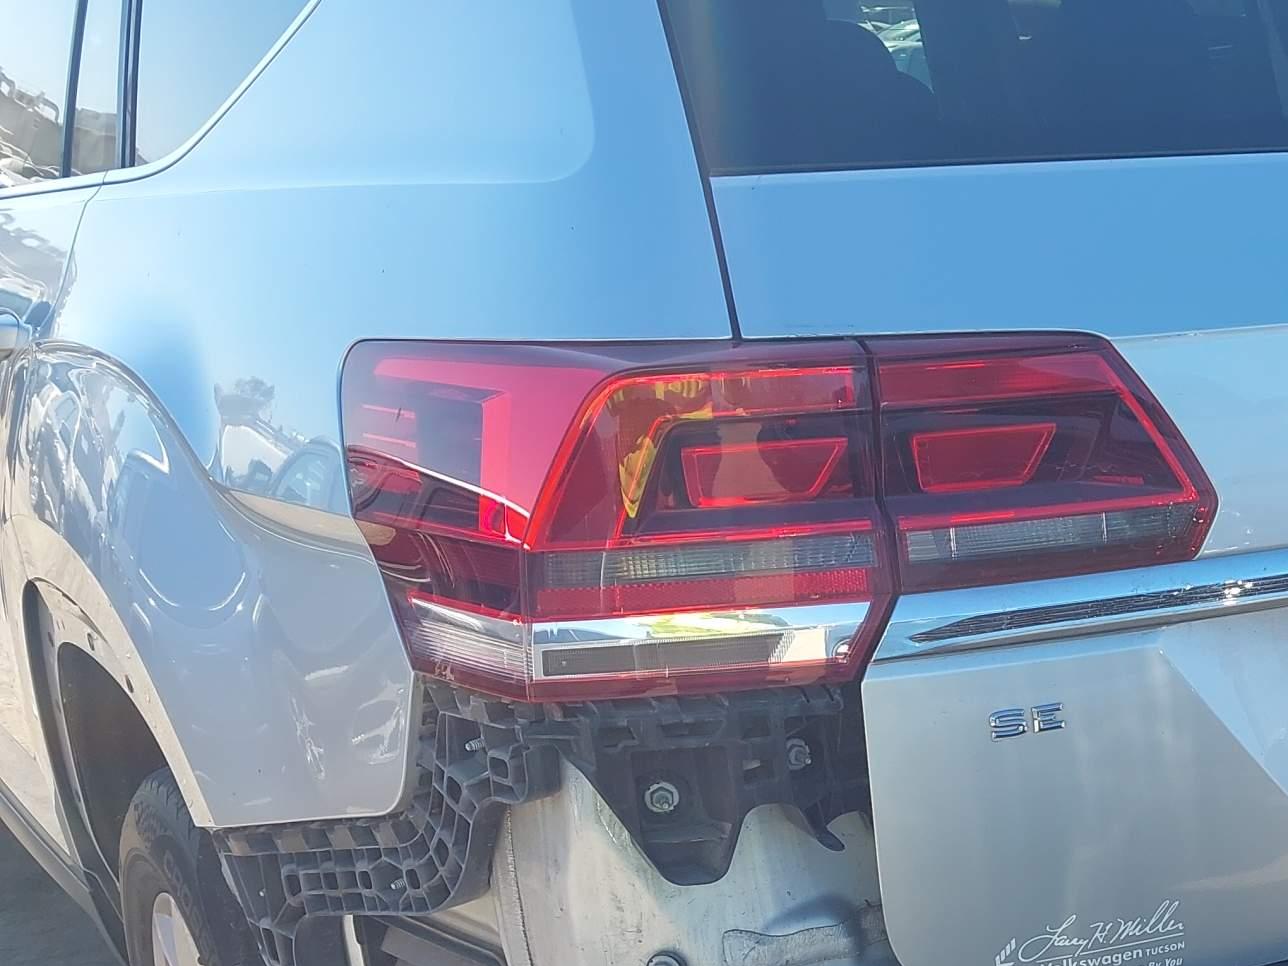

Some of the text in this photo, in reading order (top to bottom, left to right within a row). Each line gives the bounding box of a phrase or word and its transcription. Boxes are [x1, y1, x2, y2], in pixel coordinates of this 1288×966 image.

[989, 702, 1066, 740] SE
[1111, 900, 1185, 943] Miller
[1146, 941, 1185, 957] TUCSON
